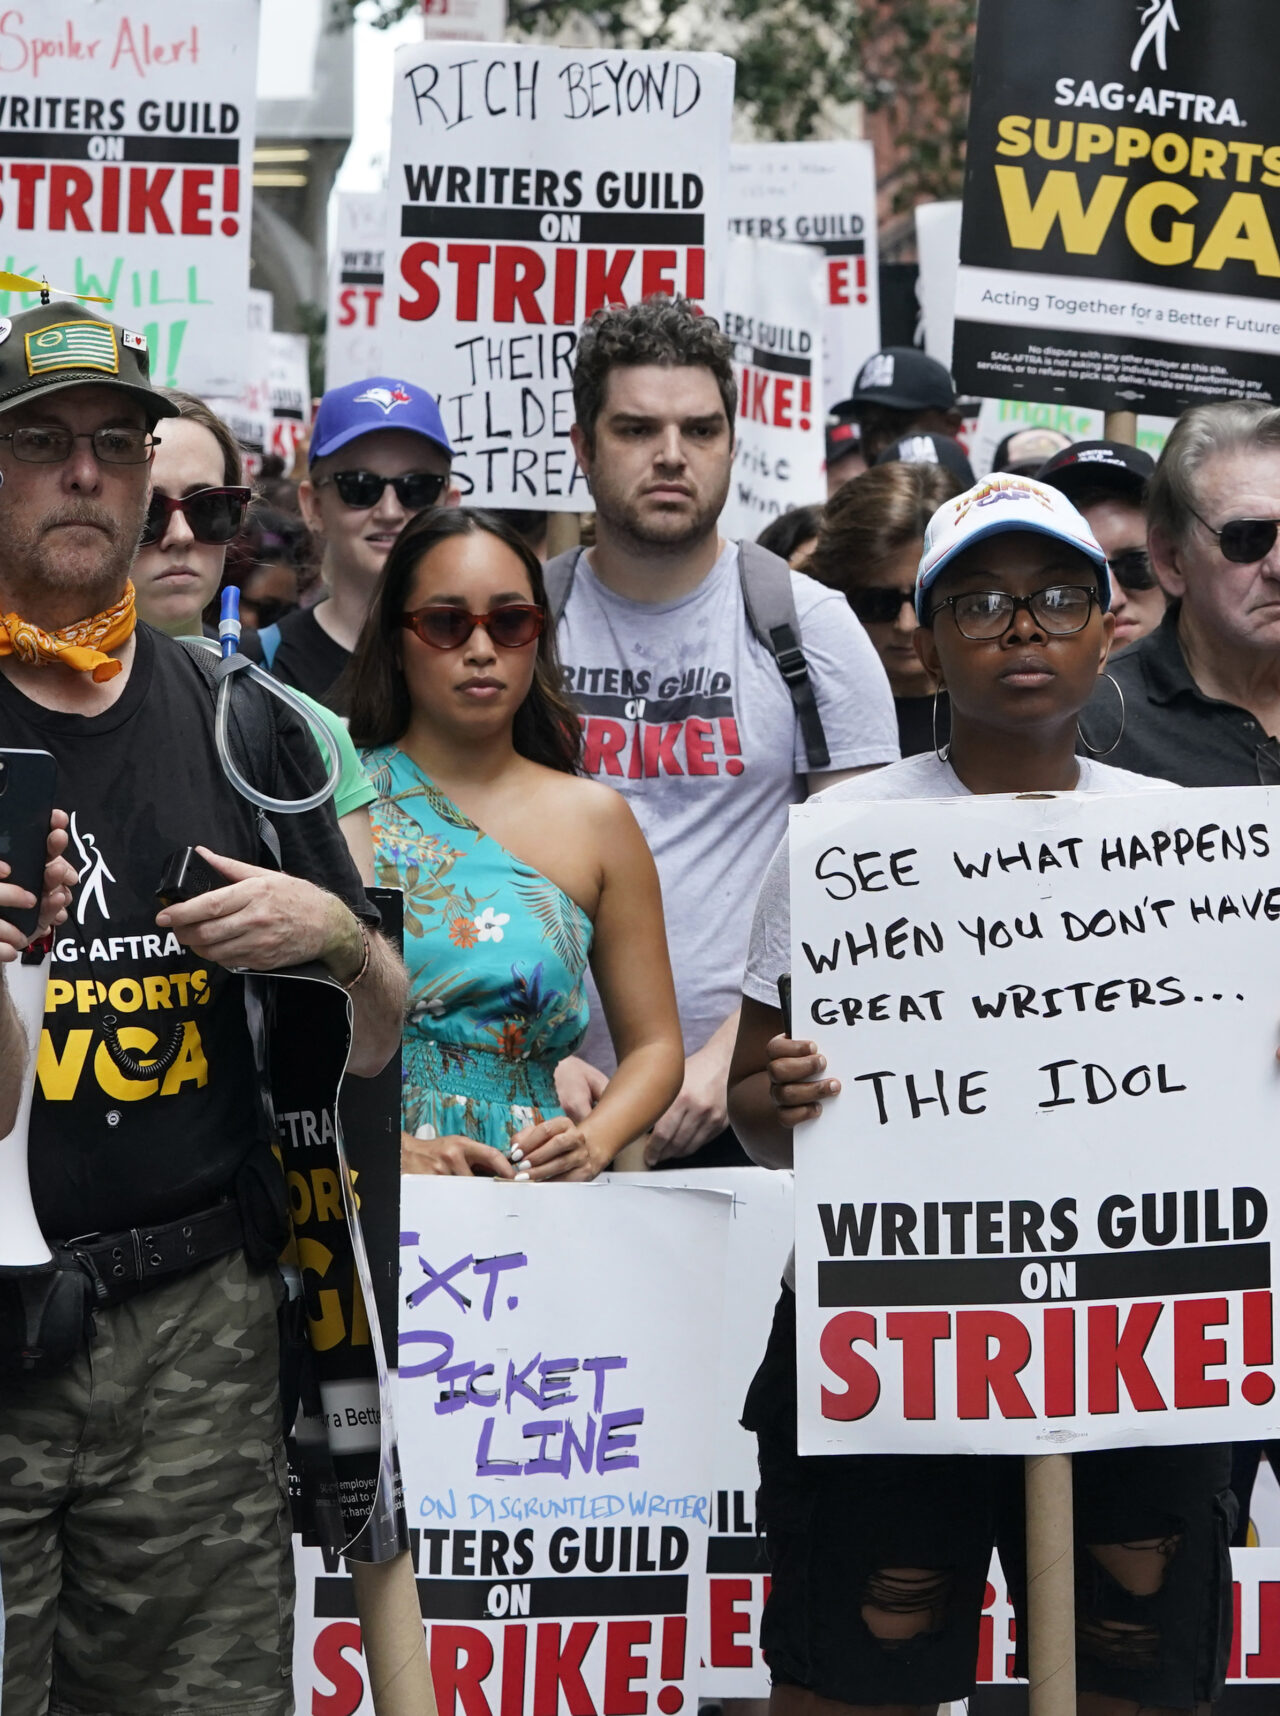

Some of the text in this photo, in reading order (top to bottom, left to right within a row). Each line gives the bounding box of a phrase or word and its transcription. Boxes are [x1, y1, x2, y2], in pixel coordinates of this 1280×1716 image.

[0, 10, 200, 79] Spoiler Alert
[138, 100, 240, 134] GUILD
[404, 58, 701, 131] RICH BEYOND
[87, 136, 125, 161] ON
[0, 163, 240, 237] TRIKE!
[404, 164, 704, 210] WRITERS GUILD
[539, 213, 581, 243] ON
[796, 215, 864, 238] GUILD
[75, 256, 214, 312] WILL
[399, 241, 705, 326] STRIKE!
[981, 289, 1040, 312] Acting
[1046, 294, 1128, 318] Together
[1131, 302, 1152, 319] for
[1155, 309, 1164, 321] a
[1168, 309, 1219, 328] Better
[455, 331, 577, 386] THEIR
[759, 322, 812, 353] GUILD
[1044, 346, 1078, 359] dispute
[1080, 348, 1101, 359] with
[1120, 353, 1143, 363] other
[1144, 357, 1180, 370] employer
[1191, 362, 1208, 373] this
[1038, 367, 1067, 378] refuse
[1053, 358, 1070, 368] not
[1071, 359, 1101, 371] asking
[1103, 362, 1120, 373] any
[1195, 374, 1245, 389] performing
[436, 387, 573, 443] ILDE
[976, 491, 1031, 508] CAP
[658, 666, 732, 698] GUILD
[577, 716, 745, 779] RIKE!
[814, 823, 1269, 901] SEE WHAT HAPPENS
[801, 916, 944, 974] WHEN
[959, 912, 1044, 956] YOU
[1061, 896, 1175, 942] DON'T
[810, 976, 1245, 1027] GREAT WRITERS...
[854, 1059, 1187, 1125] THE IDOL
[817, 1186, 1269, 1257] WRITERS GUILD
[1019, 1261, 1077, 1300] ON
[398, 1330, 628, 1416] PICKET
[819, 1290, 1276, 1422] STRIKE!
[345, 1407, 381, 1426] Bette
[475, 1408, 645, 1479] LINE
[340, 1477, 376, 1492] employer
[419, 1490, 708, 1525] ON DISGRUNTLED WRITER
[549, 1525, 690, 1575] GUILD
[486, 1583, 531, 1618] ON
[312, 1616, 687, 1716] SRIKE!
